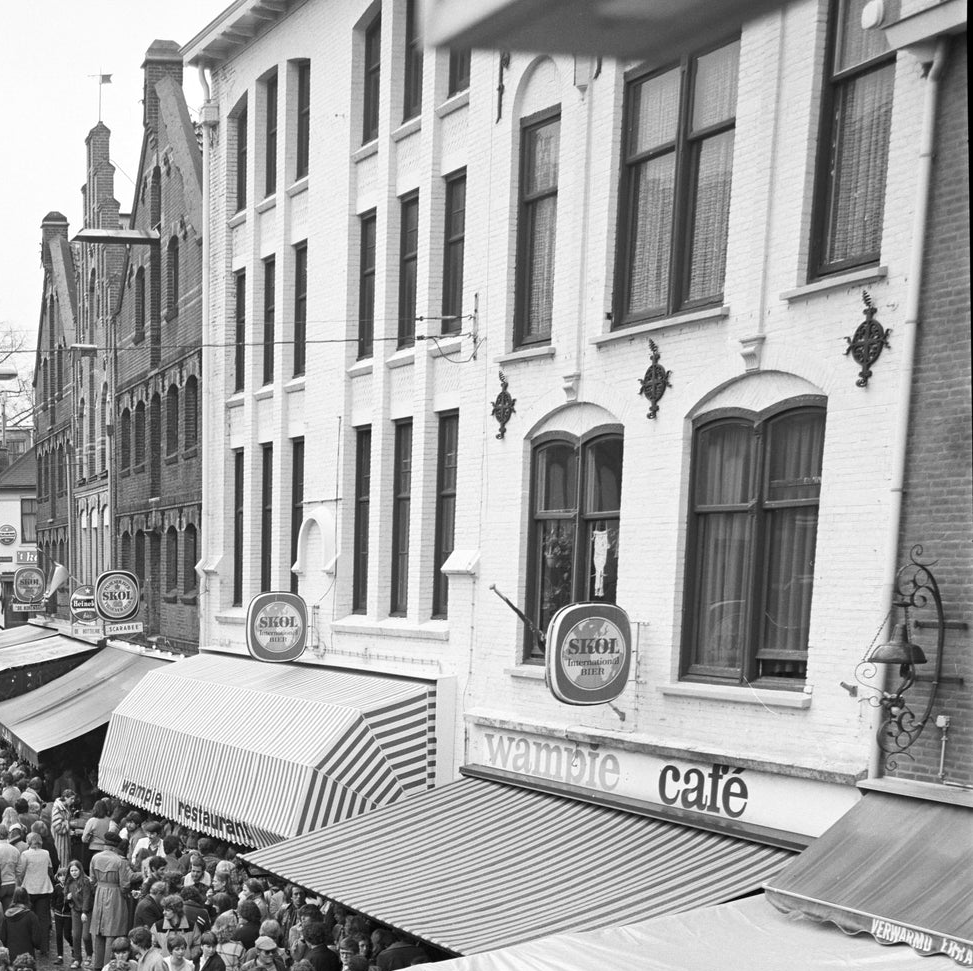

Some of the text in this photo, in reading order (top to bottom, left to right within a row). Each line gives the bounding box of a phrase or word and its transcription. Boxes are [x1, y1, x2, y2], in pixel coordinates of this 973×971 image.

[102, 591, 133, 601] SKOL
[259, 615, 298, 628] SKOL
[567, 637, 621, 655] SKOL
[567, 655, 620, 667] International
[580, 667, 605, 676] BIER
[484, 732, 749, 819] wampie café
[121, 778, 253, 840] wampie restaurant
[870, 917, 933, 952] VERWARMD
